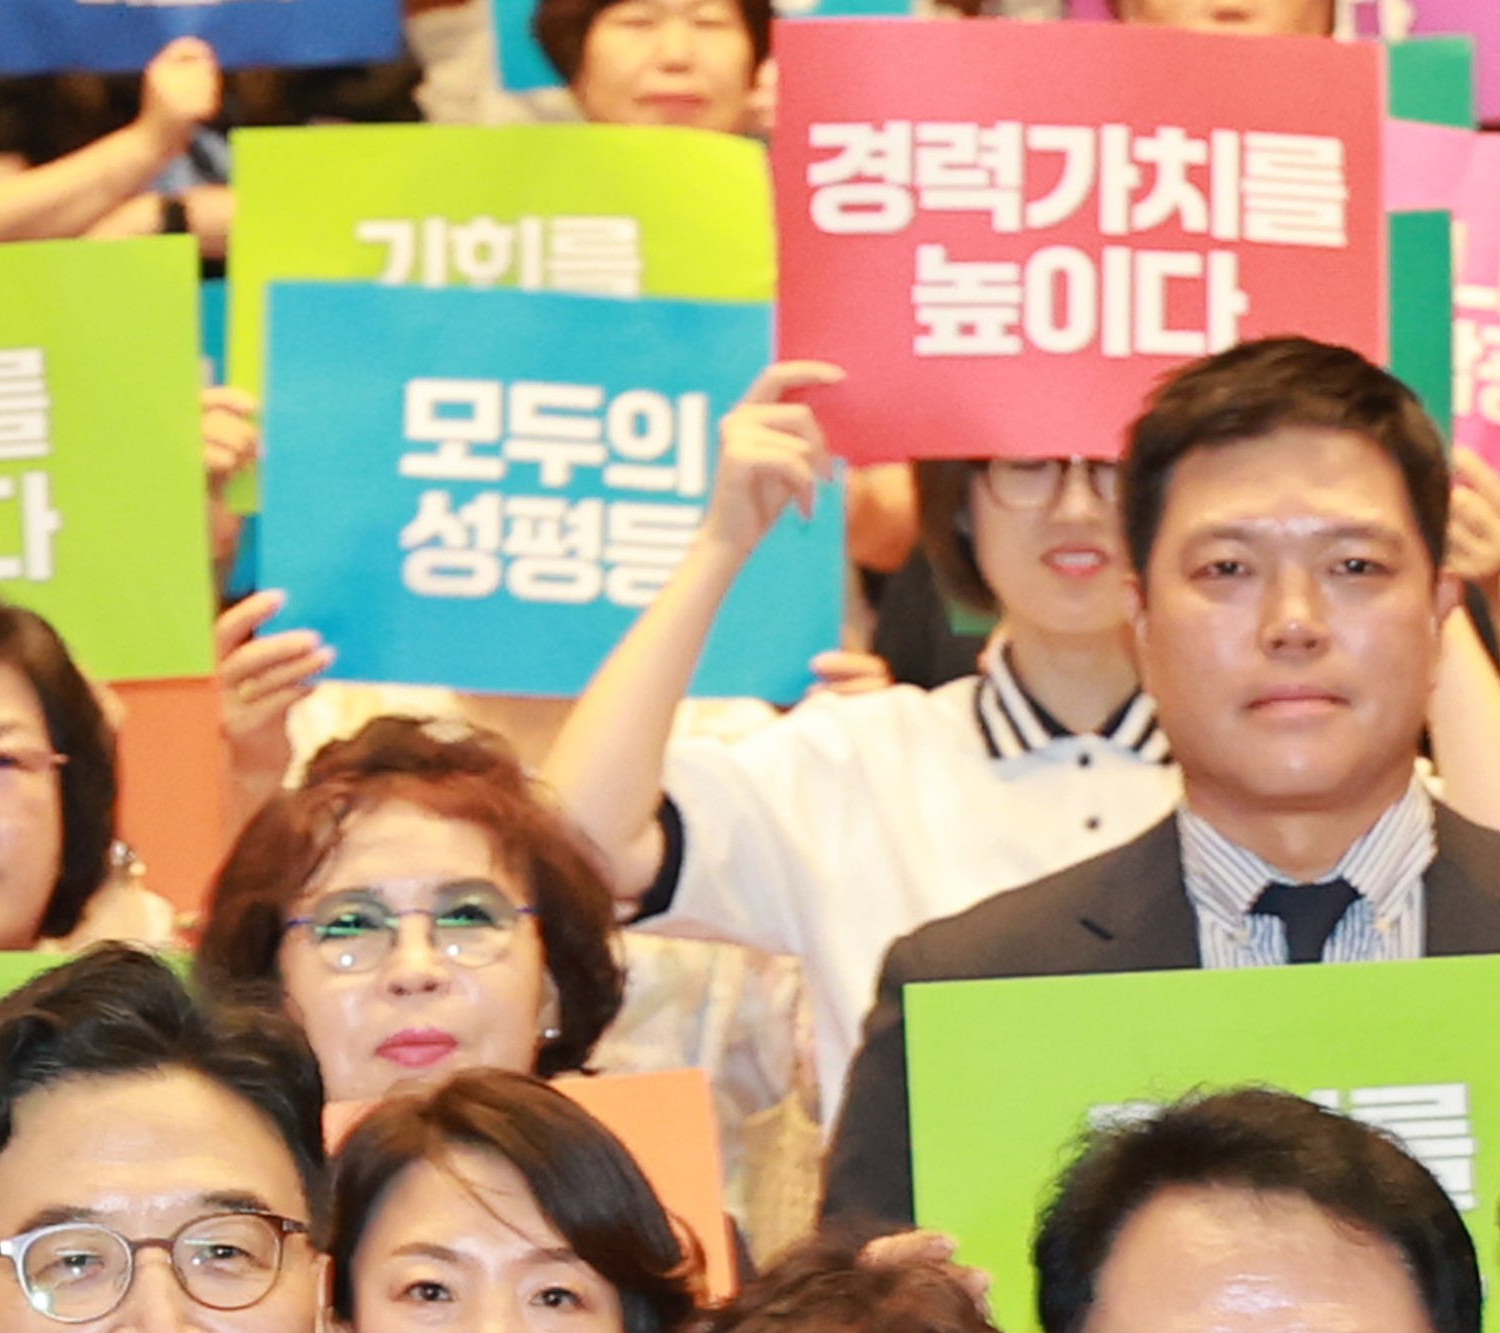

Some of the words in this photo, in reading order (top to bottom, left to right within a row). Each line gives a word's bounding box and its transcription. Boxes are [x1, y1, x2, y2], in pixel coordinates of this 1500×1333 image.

[806, 121, 1350, 248] 경력가치를
[911, 245, 1248, 360] 높이다
[397, 378, 710, 497] 모두의
